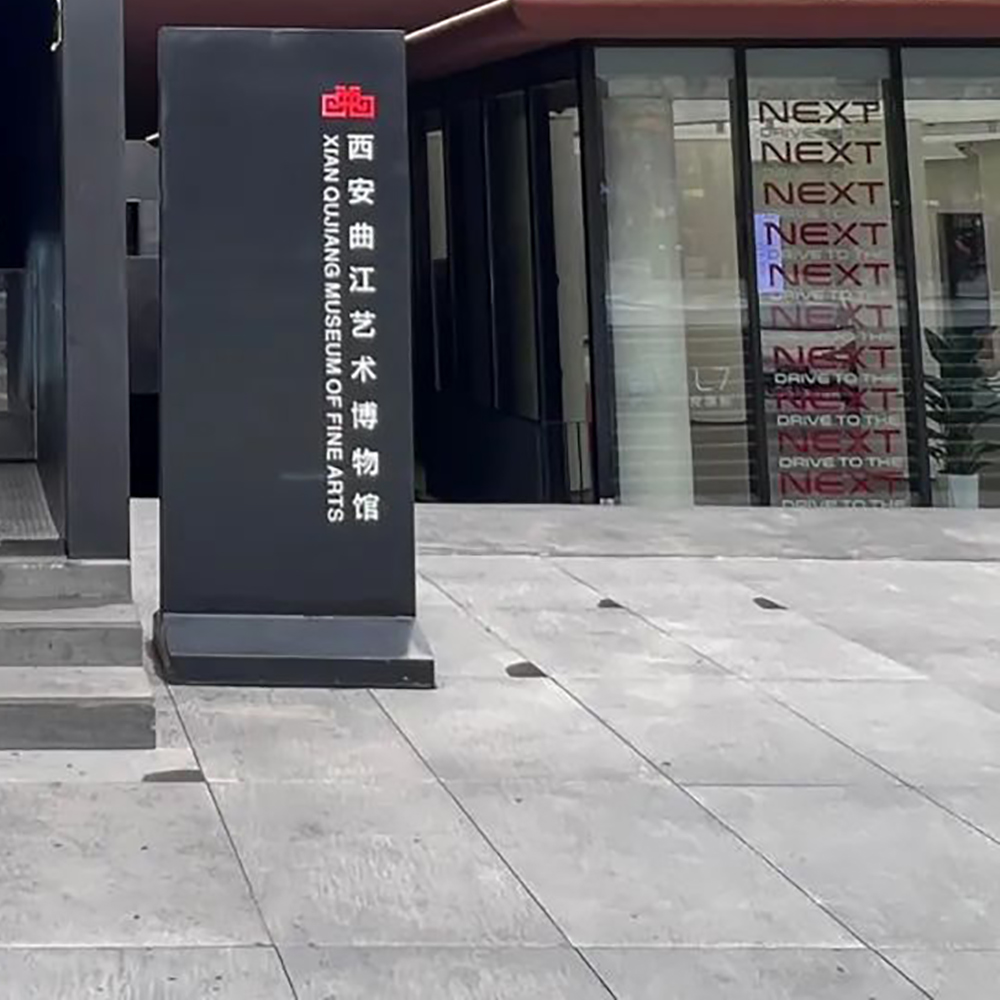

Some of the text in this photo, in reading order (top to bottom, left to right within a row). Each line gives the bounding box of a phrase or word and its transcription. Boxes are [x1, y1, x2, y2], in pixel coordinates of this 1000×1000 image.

[759, 101, 880, 123] NEXT
[761, 141, 881, 164] NEXT
[763, 182, 884, 205] NEXT
[323, 186, 341, 279] QUJIANG
[764, 222, 887, 245] NEXT
[769, 263, 889, 287] NEXT
[324, 282, 342, 374] MUSEUM
[347, 134, 380, 521] 西安曲江艺术博物馆
[771, 304, 892, 329] NEXT
[773, 345, 895, 369] NEXT
[774, 373, 830, 385] DRIVE
[833, 373, 857, 384] TO
[325, 378, 342, 408] OF
[776, 387, 898, 411] NEXT
[777, 415, 832, 427] DRIVE
[835, 415, 860, 426] TO
[326, 412, 343, 461] FINE
[778, 429, 900, 453] NEXT
[779, 456, 902, 468] DRIVE TO THE
[326, 465, 344, 522] ARTS
[780, 471, 904, 496] NEXT
